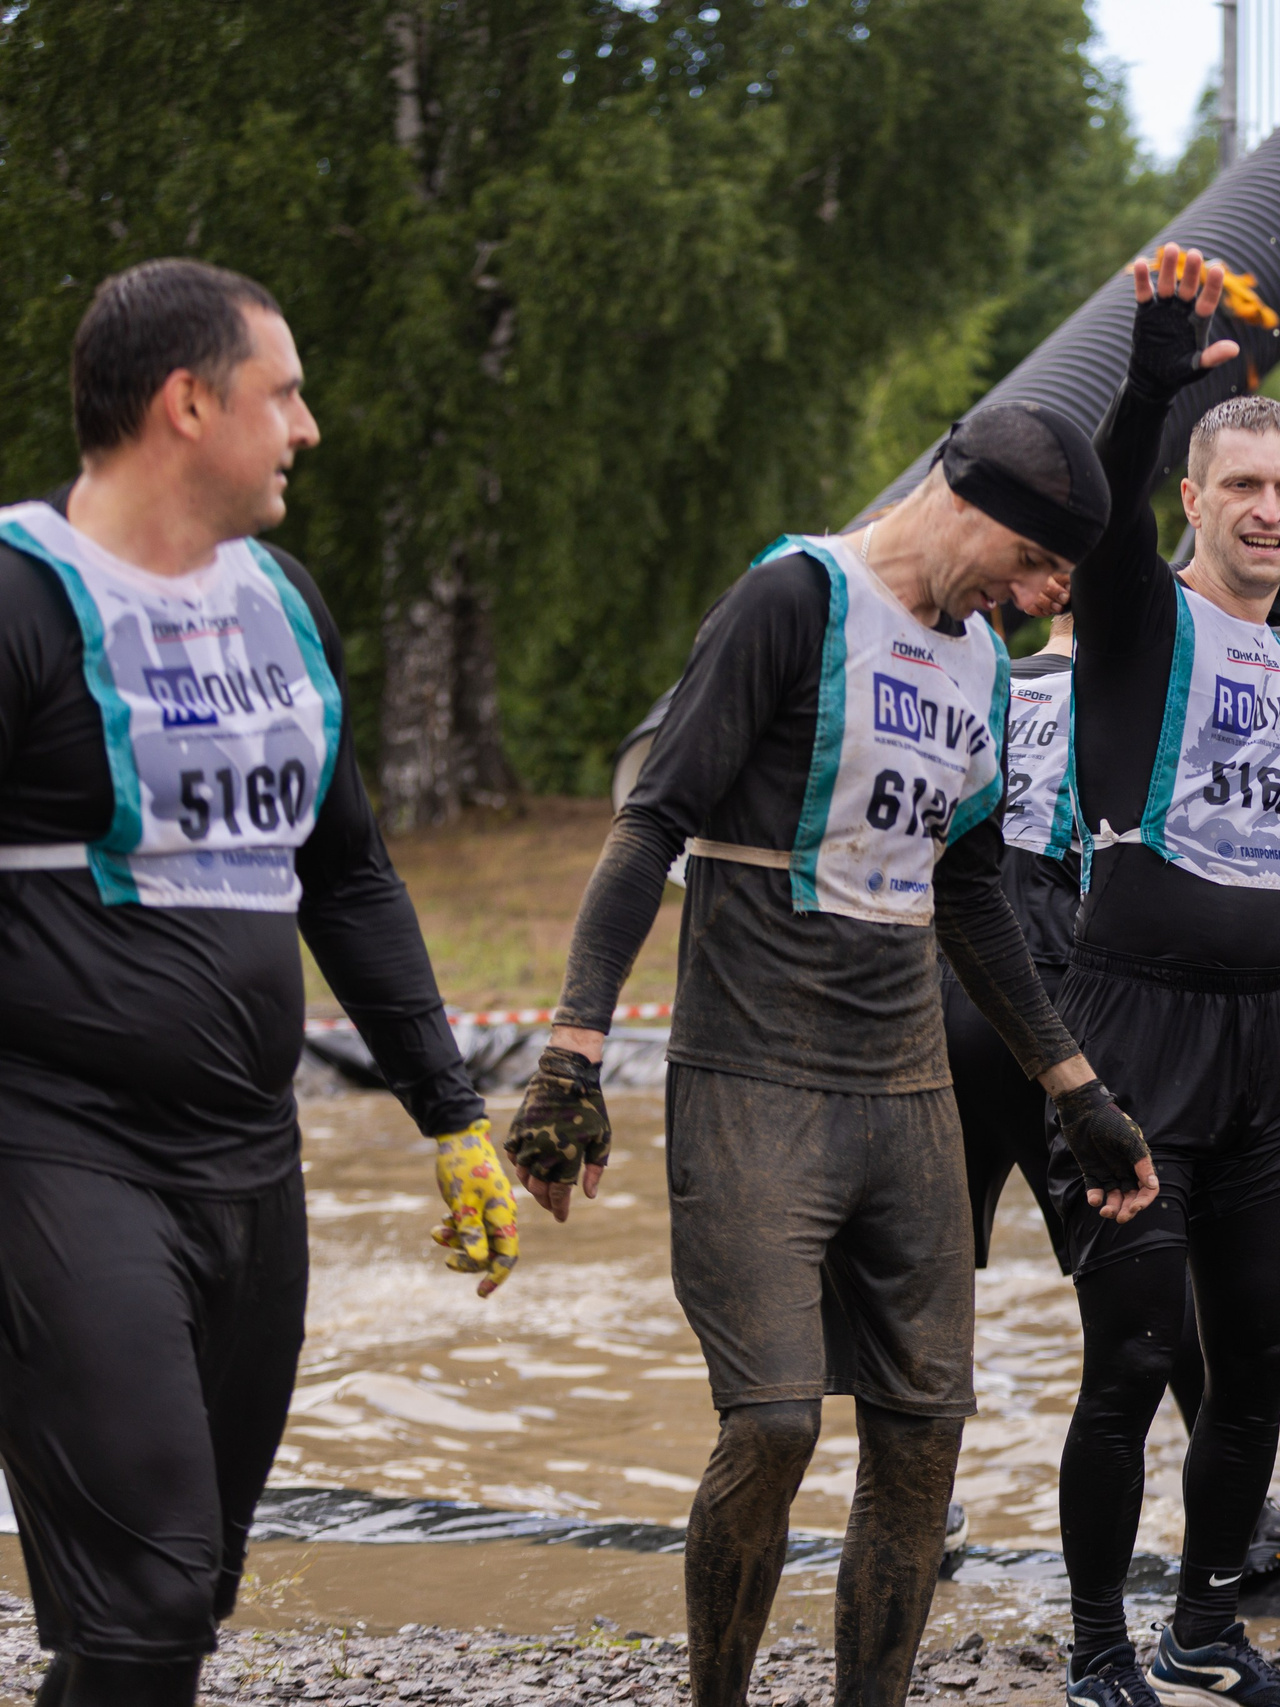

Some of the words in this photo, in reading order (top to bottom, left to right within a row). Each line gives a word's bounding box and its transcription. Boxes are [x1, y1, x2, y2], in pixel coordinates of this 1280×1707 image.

[892, 640, 935, 662] ГОНКА
[1226, 647, 1262, 662] ГОНКА
[146, 663, 294, 724] RODVIG
[178, 758, 306, 842] 5160
